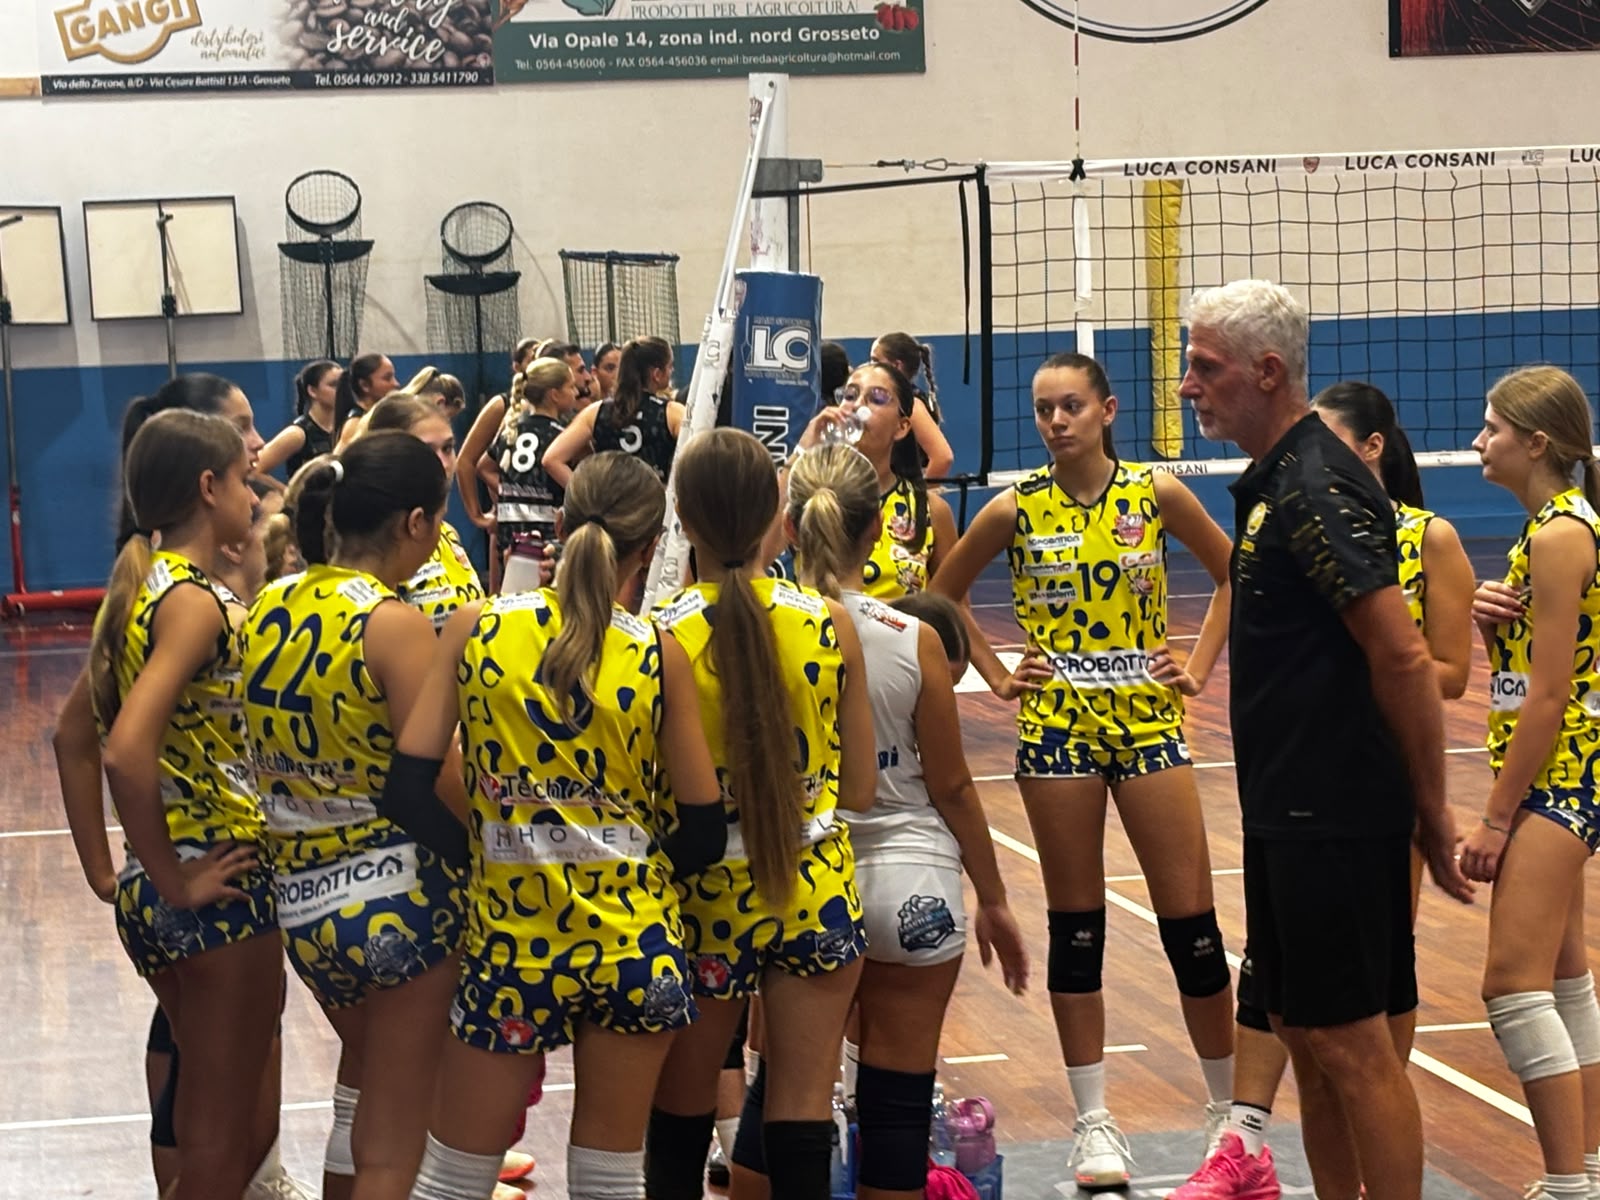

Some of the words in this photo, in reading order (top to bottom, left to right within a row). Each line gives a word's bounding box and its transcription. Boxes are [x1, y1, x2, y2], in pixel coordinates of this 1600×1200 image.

[69, 0, 184, 44] GANGI
[363, 8, 409, 33] and
[631, 4, 706, 19] PRODOTTI
[713, 3, 738, 17] PER
[746, 1, 857, 16] L'AGRICOLTURA
[190, 25, 264, 49] distributori
[327, 23, 446, 63] service
[529, 32, 559, 49] Via
[565, 32, 619, 51] Opale
[625, 31, 654, 49] 14,
[660, 33, 703, 46] zona
[710, 29, 743, 44] ind.
[750, 28, 792, 43] nord
[798, 26, 880, 42] Grosseto
[200, 46, 267, 61] automatici
[515, 59, 533, 70] Tel.
[536, 58, 606, 70] 0564-456006
[616, 57, 635, 68] FAX
[638, 56, 708, 67] 0564-456036
[53, 78, 67, 89] Via
[149, 76, 163, 88] Via
[253, 74, 291, 86] Grosseto
[314, 74, 332, 86] Tel.
[333, 74, 360, 86] 0564
[362, 73, 402, 85] 467912
[410, 73, 431, 85] 338
[432, 71, 479, 84] 5411790
[1124, 162, 1178, 177] LUCA
[1185, 158, 1277, 175] CONSANI
[1345, 155, 1398, 171] LUCA
[1405, 151, 1496, 169] CONSANI
[753, 326, 810, 371] LC
[511, 432, 539, 473] 8
[1151, 463, 1208, 475] ONSANI
[1077, 559, 1121, 603] 19
[247, 606, 322, 714] 22
[279, 854, 404, 905] ROBATICA
